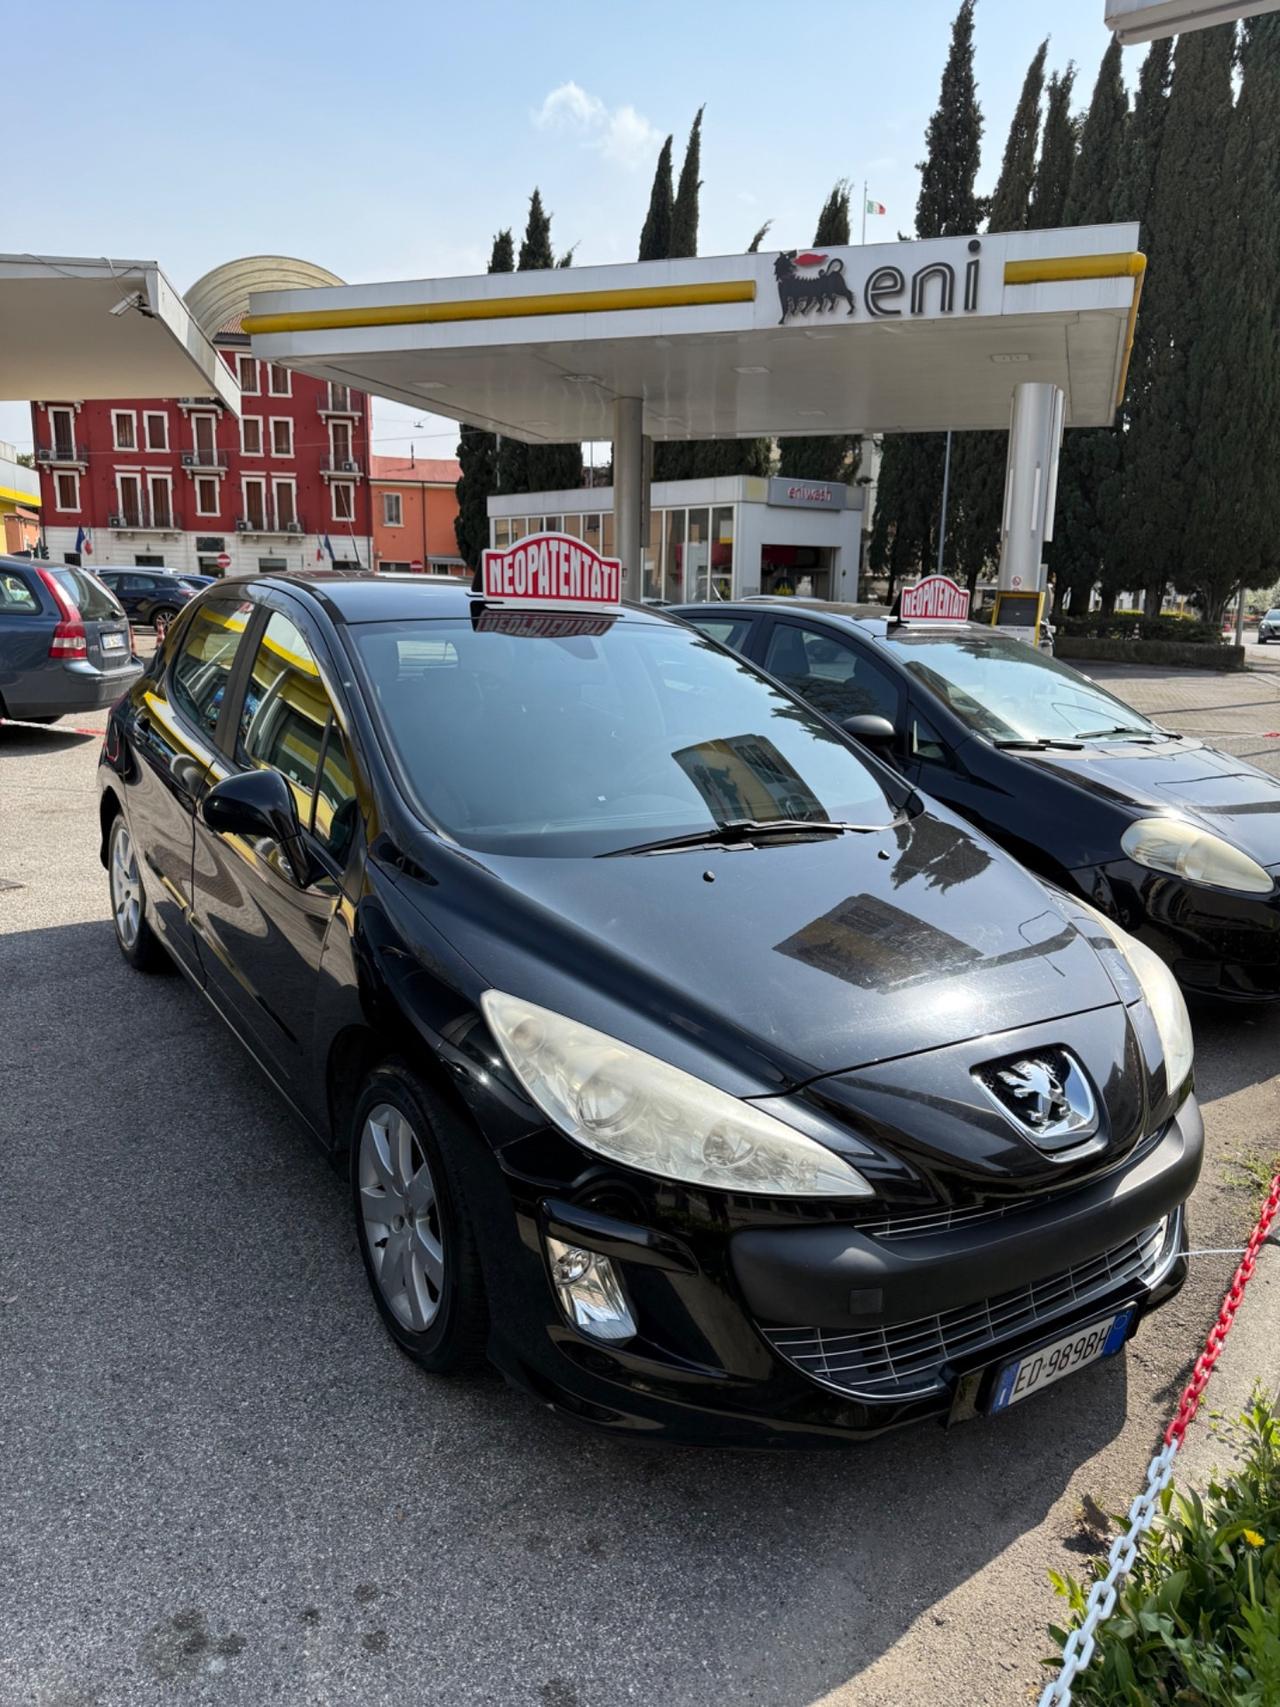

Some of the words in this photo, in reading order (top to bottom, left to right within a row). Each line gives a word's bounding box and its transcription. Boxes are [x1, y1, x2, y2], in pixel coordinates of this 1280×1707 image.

[864, 239, 982, 317] eni
[489, 540, 617, 600] NEOPATENTATI
[905, 579, 968, 618] NEOPATENTATI
